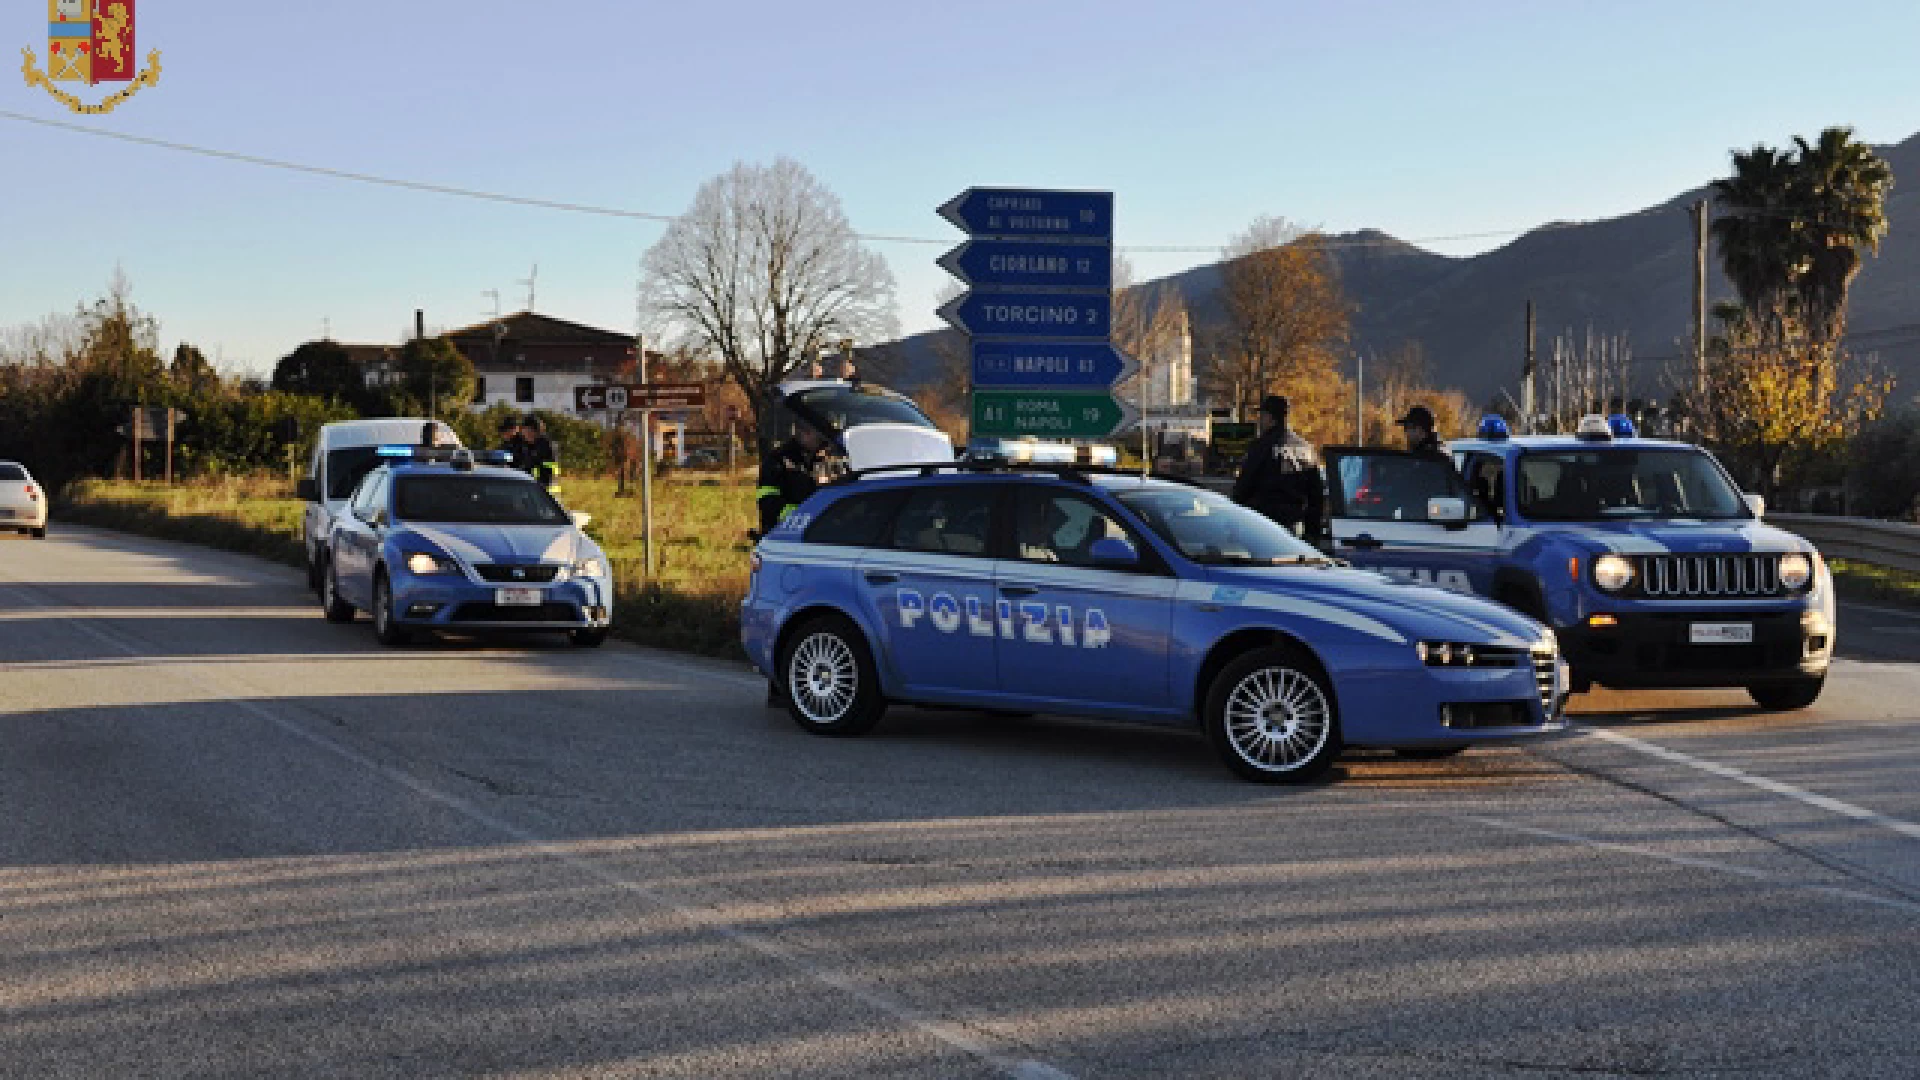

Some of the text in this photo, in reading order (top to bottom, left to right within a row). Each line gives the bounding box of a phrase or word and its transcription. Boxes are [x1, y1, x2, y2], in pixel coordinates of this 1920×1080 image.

[983, 305, 1078, 324] TORCINO
[1013, 355, 1069, 373] NAPOLI
[984, 405, 1003, 421] A1
[1016, 399, 1060, 412] ROMA
[1014, 416, 1072, 430] NAPOLI
[896, 587, 1112, 649] POLIZIA
